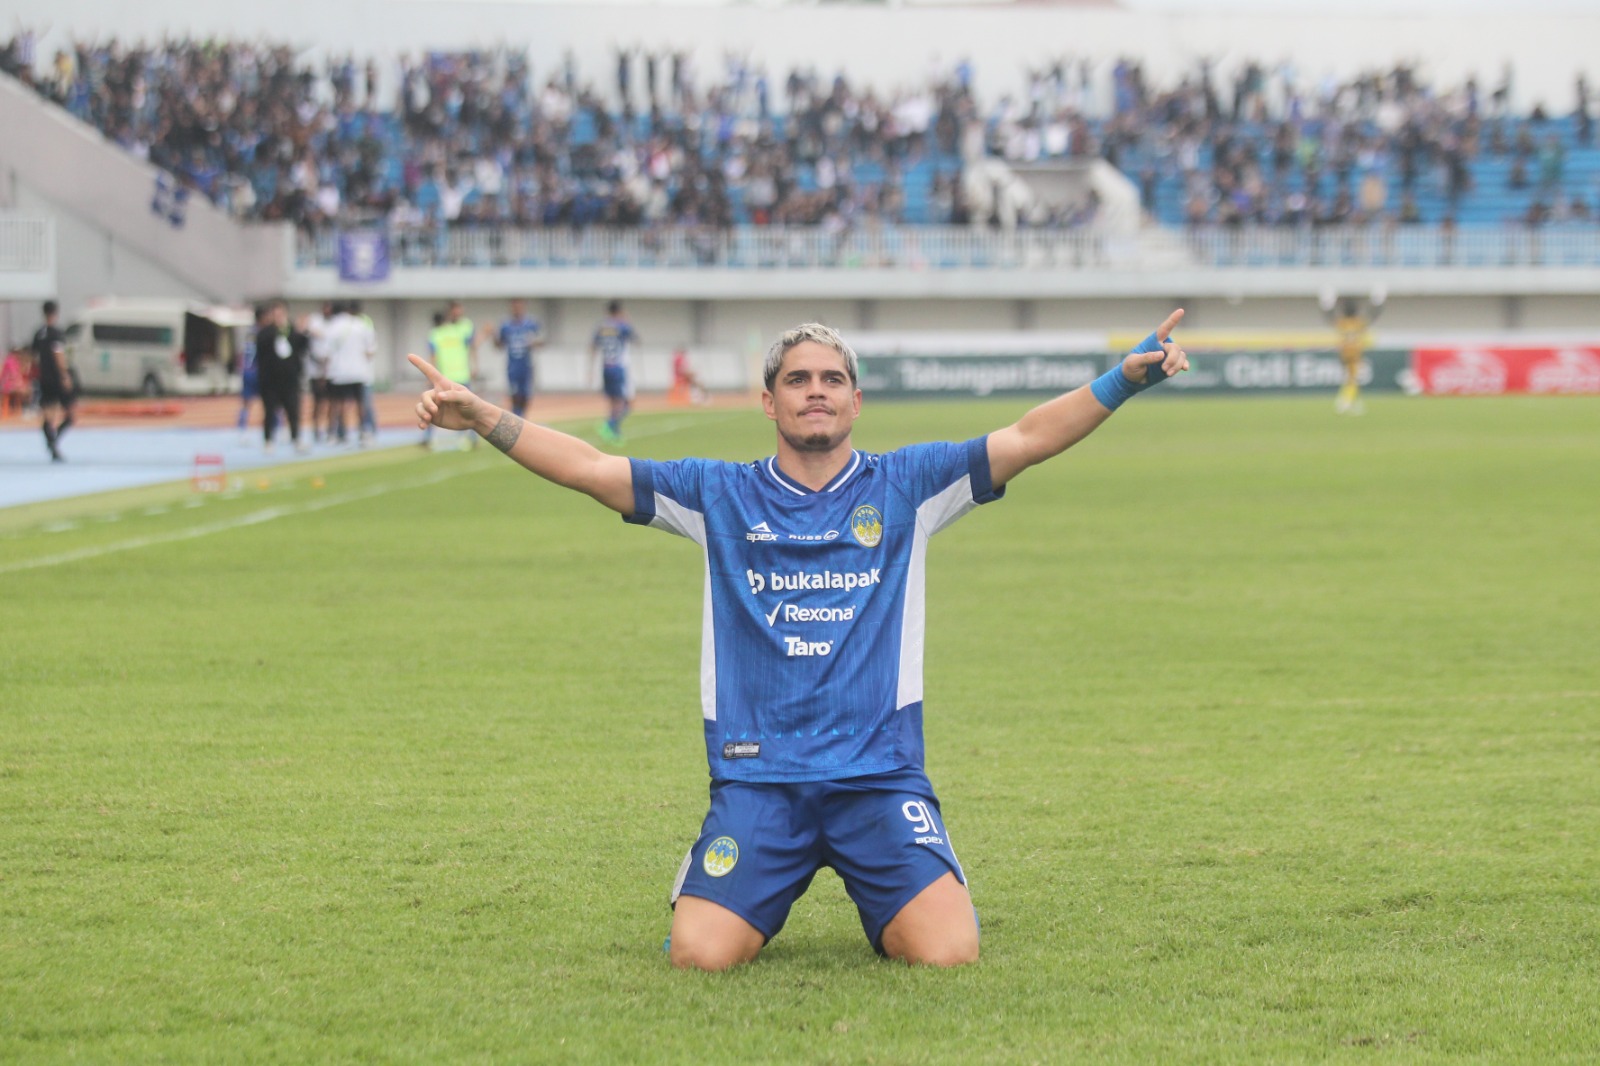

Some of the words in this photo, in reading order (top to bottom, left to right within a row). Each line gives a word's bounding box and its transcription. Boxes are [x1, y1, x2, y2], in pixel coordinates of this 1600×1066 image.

[746, 532, 779, 543] apex
[771, 568, 881, 592] bukalapak
[785, 604, 854, 622] Rexona
[784, 636, 832, 656] Taro
[902, 801, 939, 835] 91
[915, 836, 944, 845] apex
